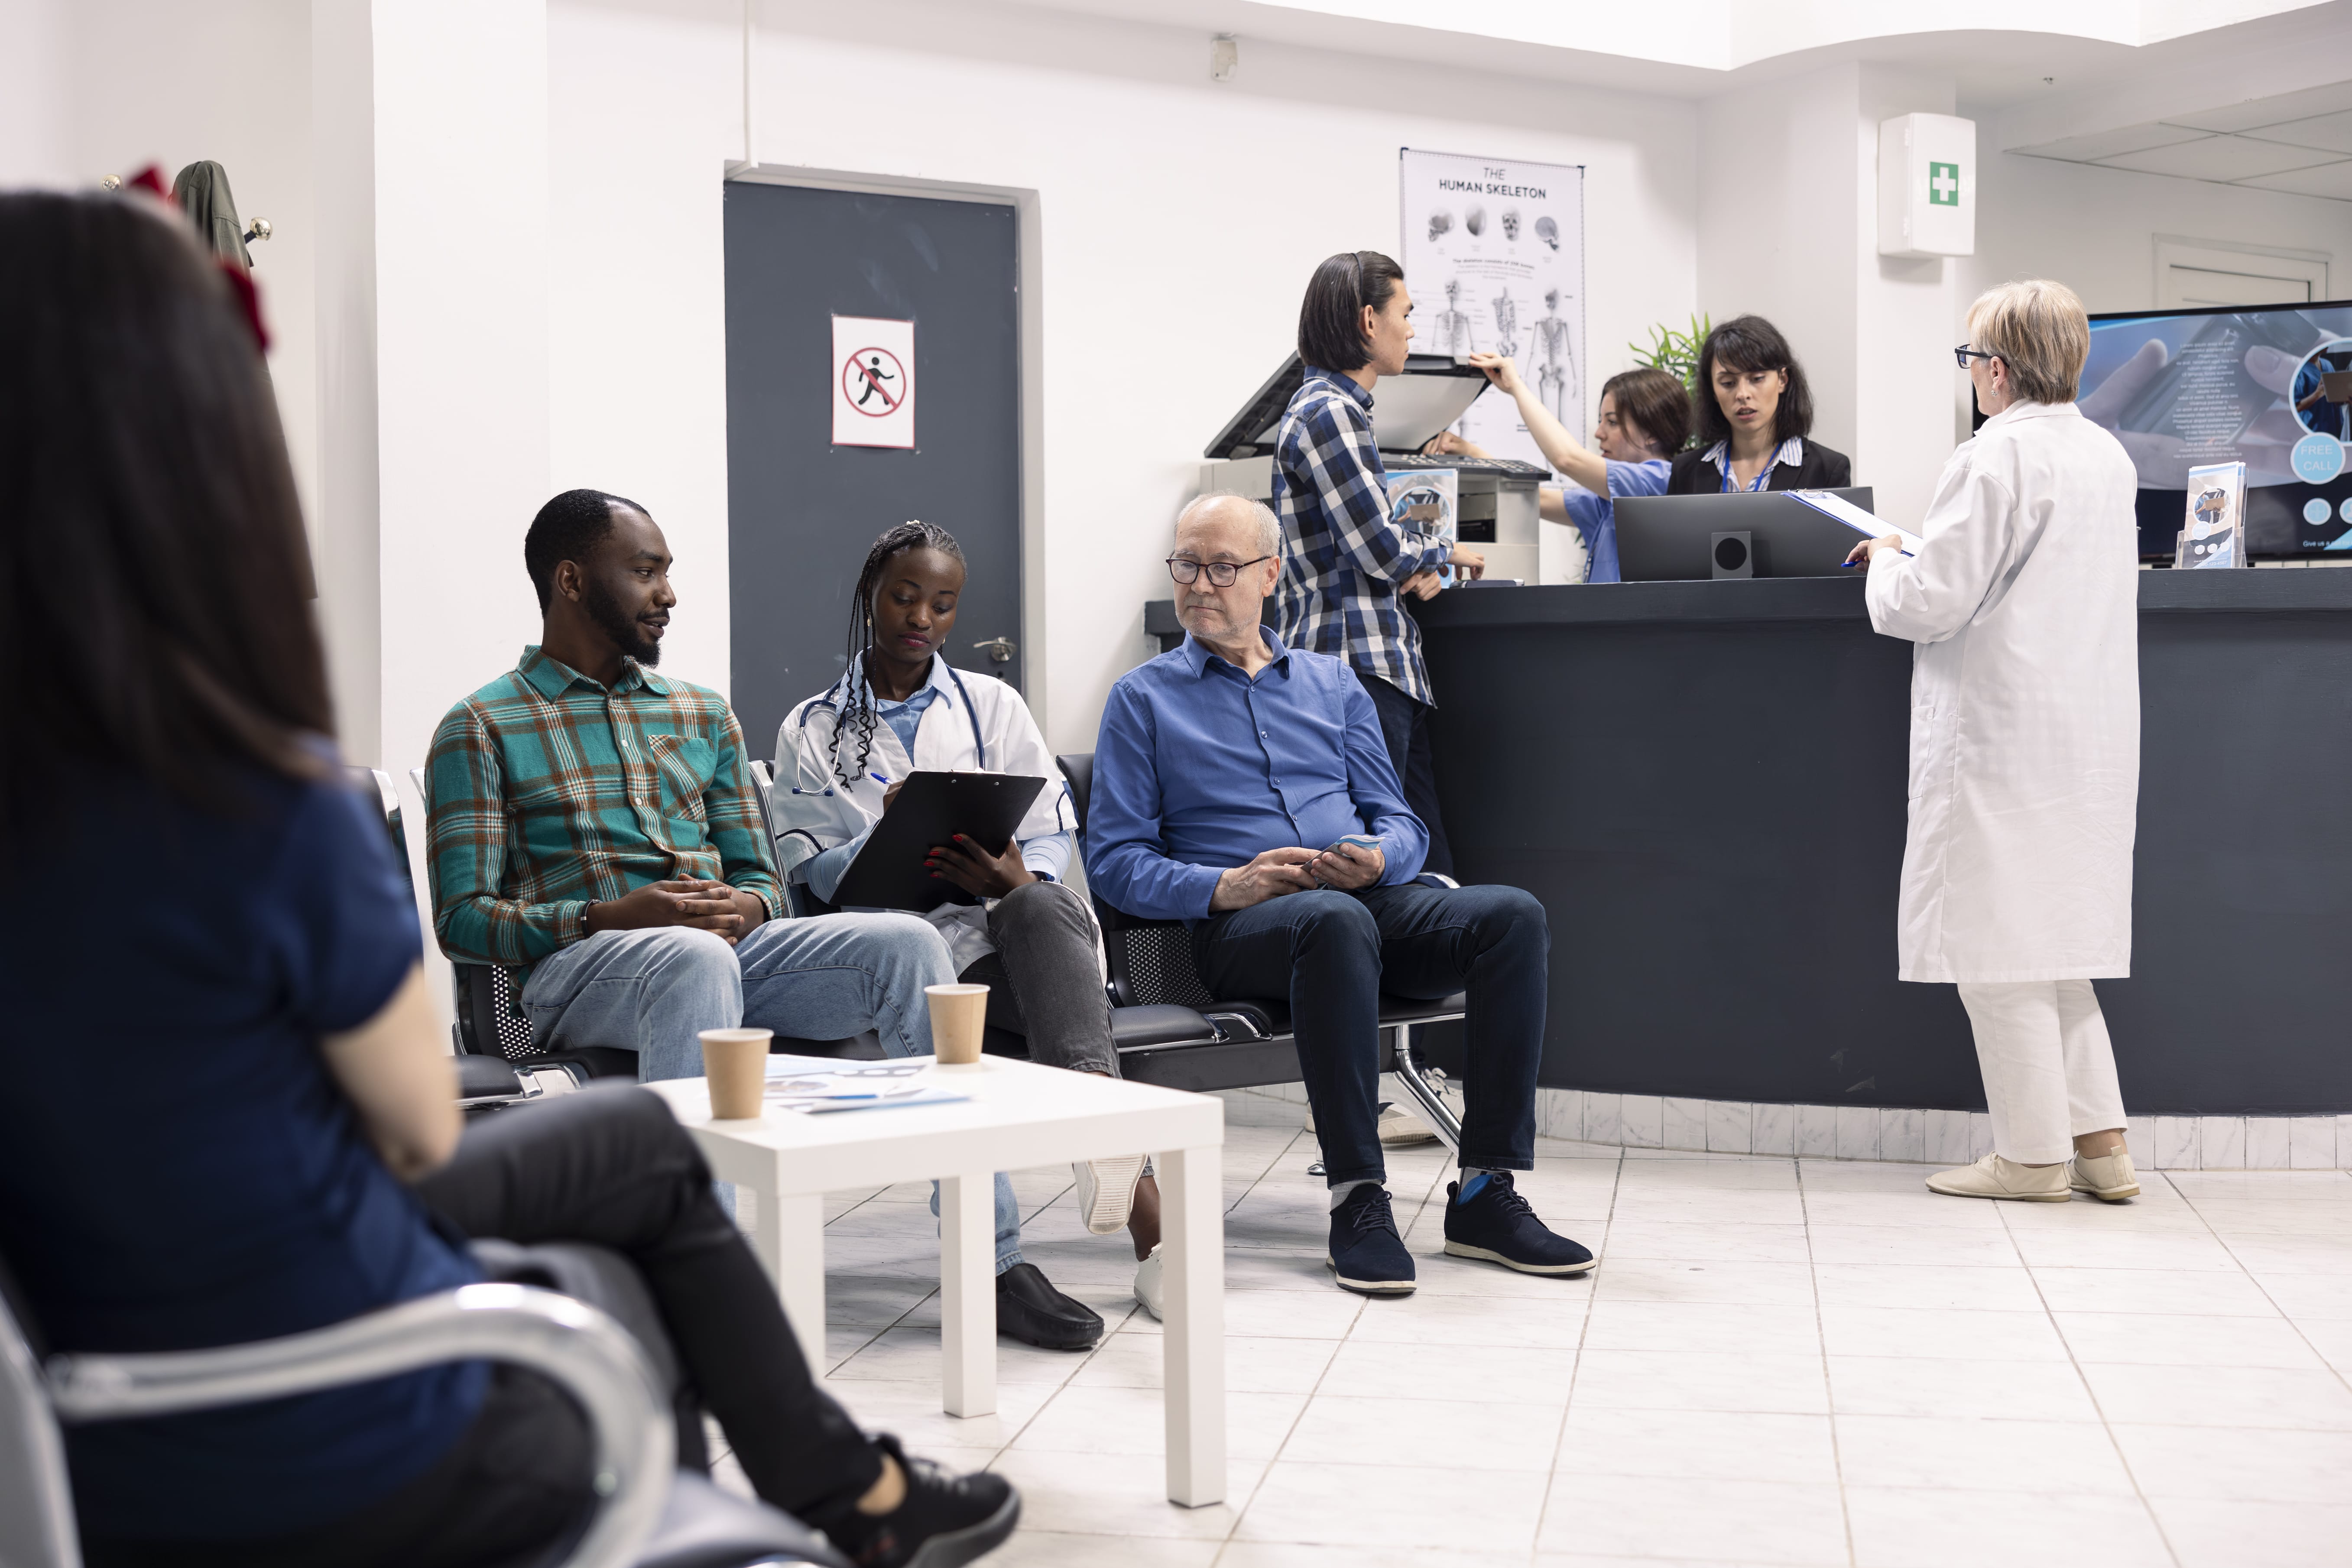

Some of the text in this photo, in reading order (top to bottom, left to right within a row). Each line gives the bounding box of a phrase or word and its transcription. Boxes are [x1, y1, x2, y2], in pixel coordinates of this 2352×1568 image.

[1483, 167, 1506, 180] THE
[1439, 179, 1546, 199] HUMAN SKELETON
[2300, 445, 2333, 455] FREE
[2303, 461, 2334, 471] CALL
